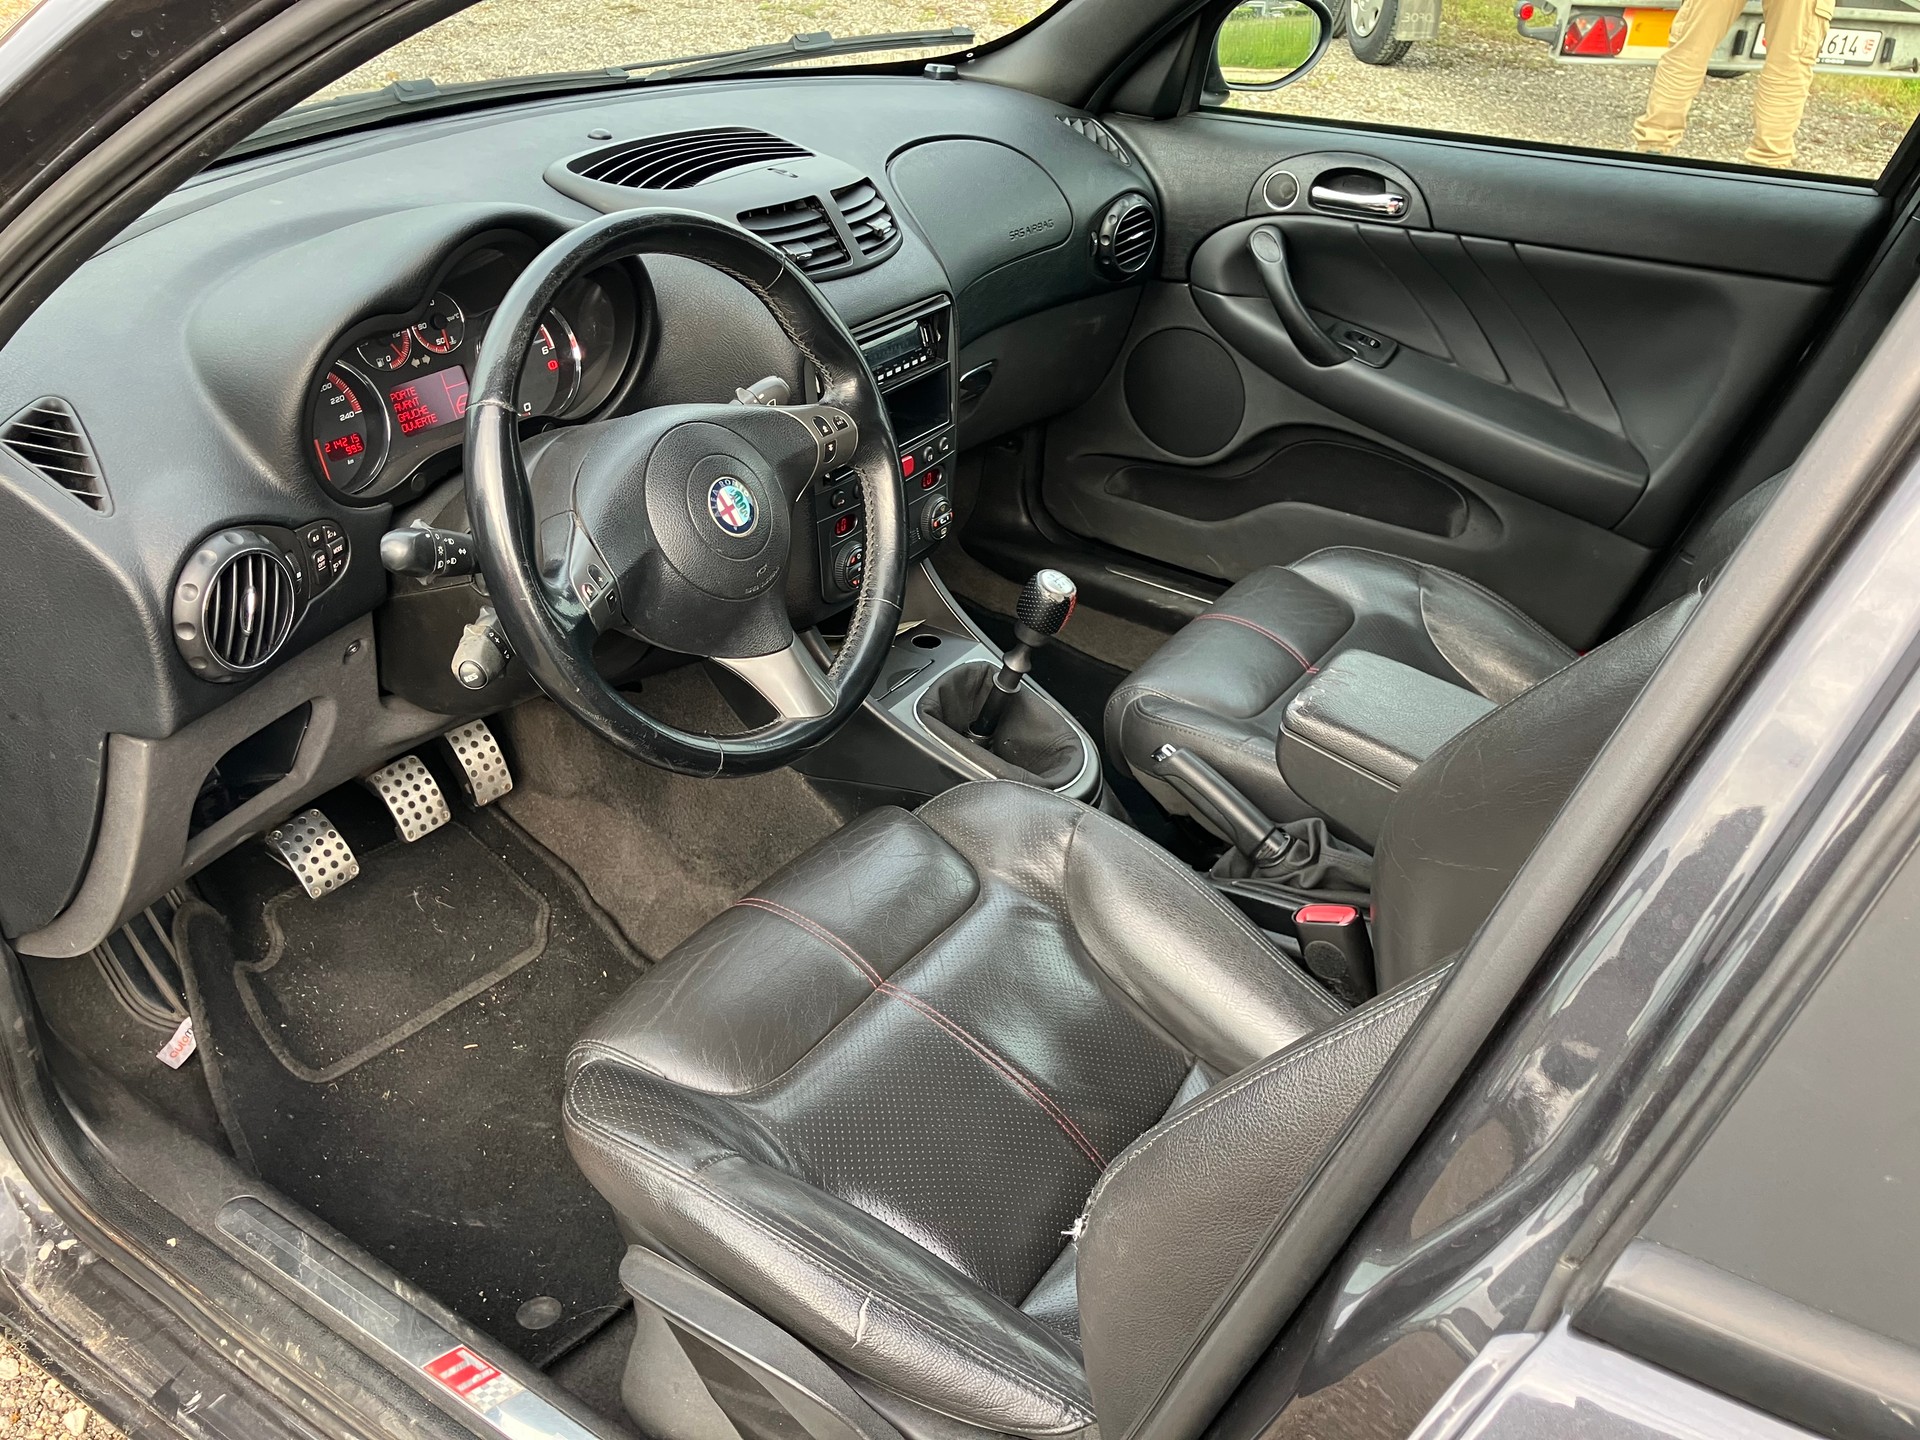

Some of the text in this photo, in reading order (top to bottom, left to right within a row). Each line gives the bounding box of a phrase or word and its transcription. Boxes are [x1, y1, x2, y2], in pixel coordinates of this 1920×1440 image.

[1820, 34, 1859, 56] 614
[320, 382, 333, 392] 00
[390, 386, 417, 402] PORTE
[330, 395, 345, 405] 220
[394, 397, 420, 412] AVANT
[340, 411, 354, 421] 240
[398, 405, 429, 423] GAUCHE
[401, 414, 438, 433] OUVERTE
